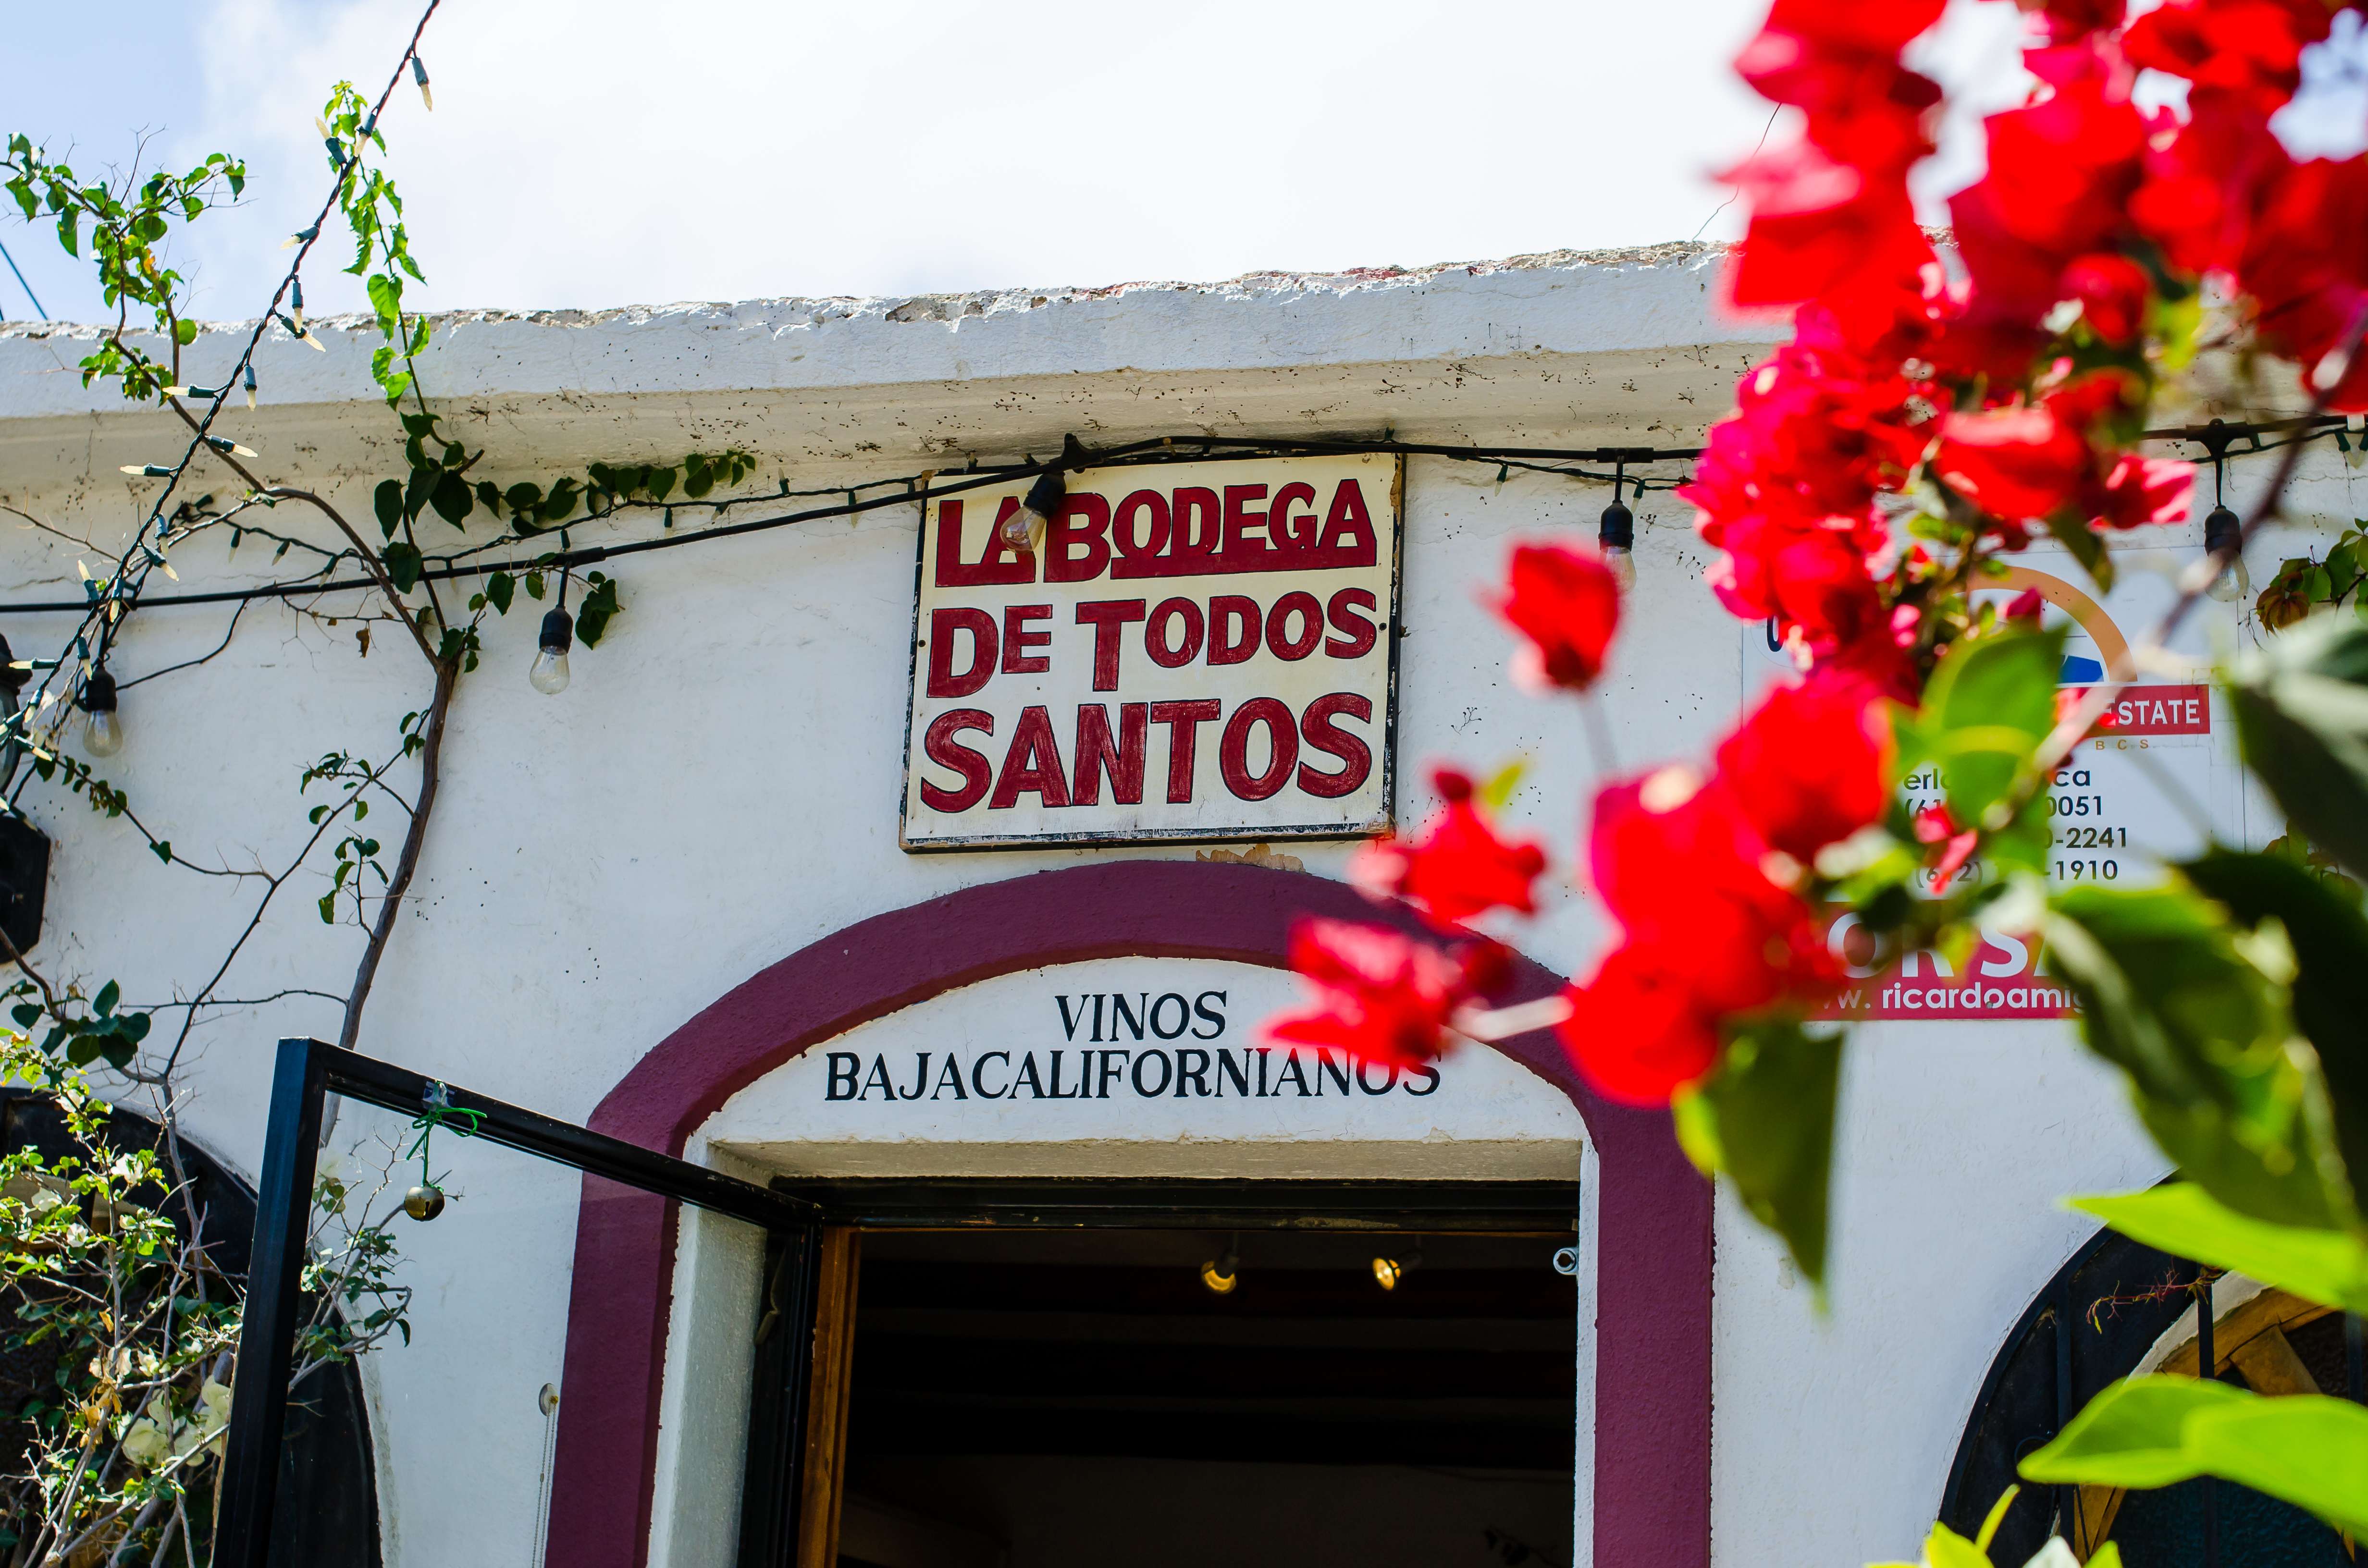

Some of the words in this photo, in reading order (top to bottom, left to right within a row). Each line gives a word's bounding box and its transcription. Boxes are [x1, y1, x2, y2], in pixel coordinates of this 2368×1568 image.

[935, 496, 1036, 588] LA
[1043, 478, 1378, 583] BODEGA
[926, 604, 1053, 698] DE
[1075, 587, 1377, 692] TODOS
[920, 692, 1372, 813] SANTOS
[1916, 861, 1983, 888] (62)
[1054, 990, 1228, 1043] VINOS
[825, 1047, 1441, 1101] BAJACALIFORNIANOS
